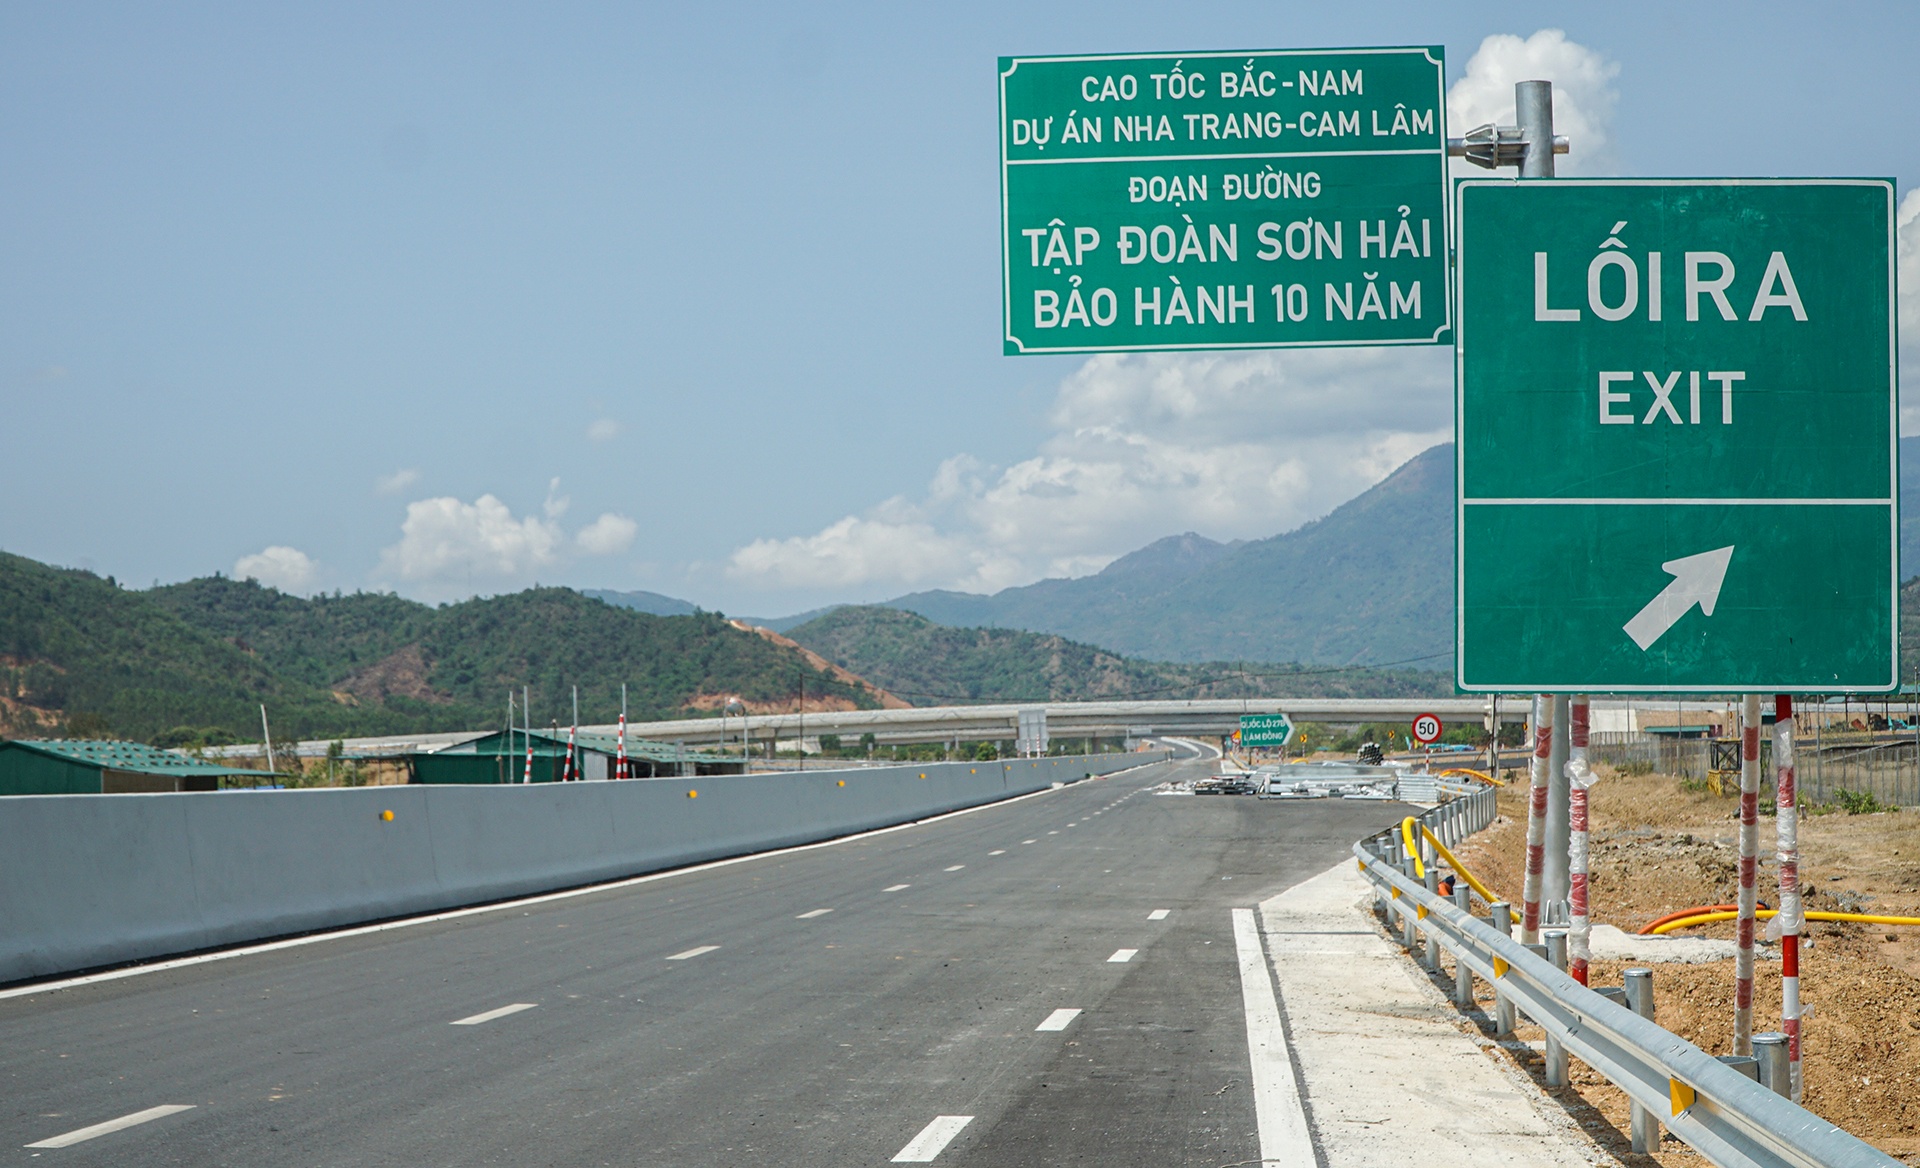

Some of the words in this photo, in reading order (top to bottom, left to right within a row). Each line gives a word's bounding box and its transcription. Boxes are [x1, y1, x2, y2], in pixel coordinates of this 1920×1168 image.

[1081, 75, 1138, 102] CAO
[1150, 58, 1206, 99] TỐC
[1220, 58, 1364, 99] BẮC-NAM
[1012, 115, 1054, 150] DỰ
[1061, 110, 1103, 144] ÁN
[1114, 115, 1175, 142] NHA
[1183, 110, 1361, 141] TRANG-CAM
[1372, 103, 1435, 137] LÂM
[1128, 174, 1208, 207] ĐOẠN
[1222, 165, 1322, 201] ĐƯỜNG
[1021, 218, 1101, 275] TẬP
[1116, 214, 1239, 265] ĐOÀN
[1256, 217, 1343, 262] SƠN
[1360, 205, 1431, 259] HẢI
[1534, 221, 1662, 322] LỐI
[1684, 251, 1809, 322] RA
[1034, 275, 1118, 329] BẢO
[1134, 275, 1255, 327] HÀNH
[1271, 283, 1308, 323] 10
[1325, 271, 1421, 322] NĂM
[1599, 371, 1746, 425] EXIT
[1419, 722, 1435, 735] 50
